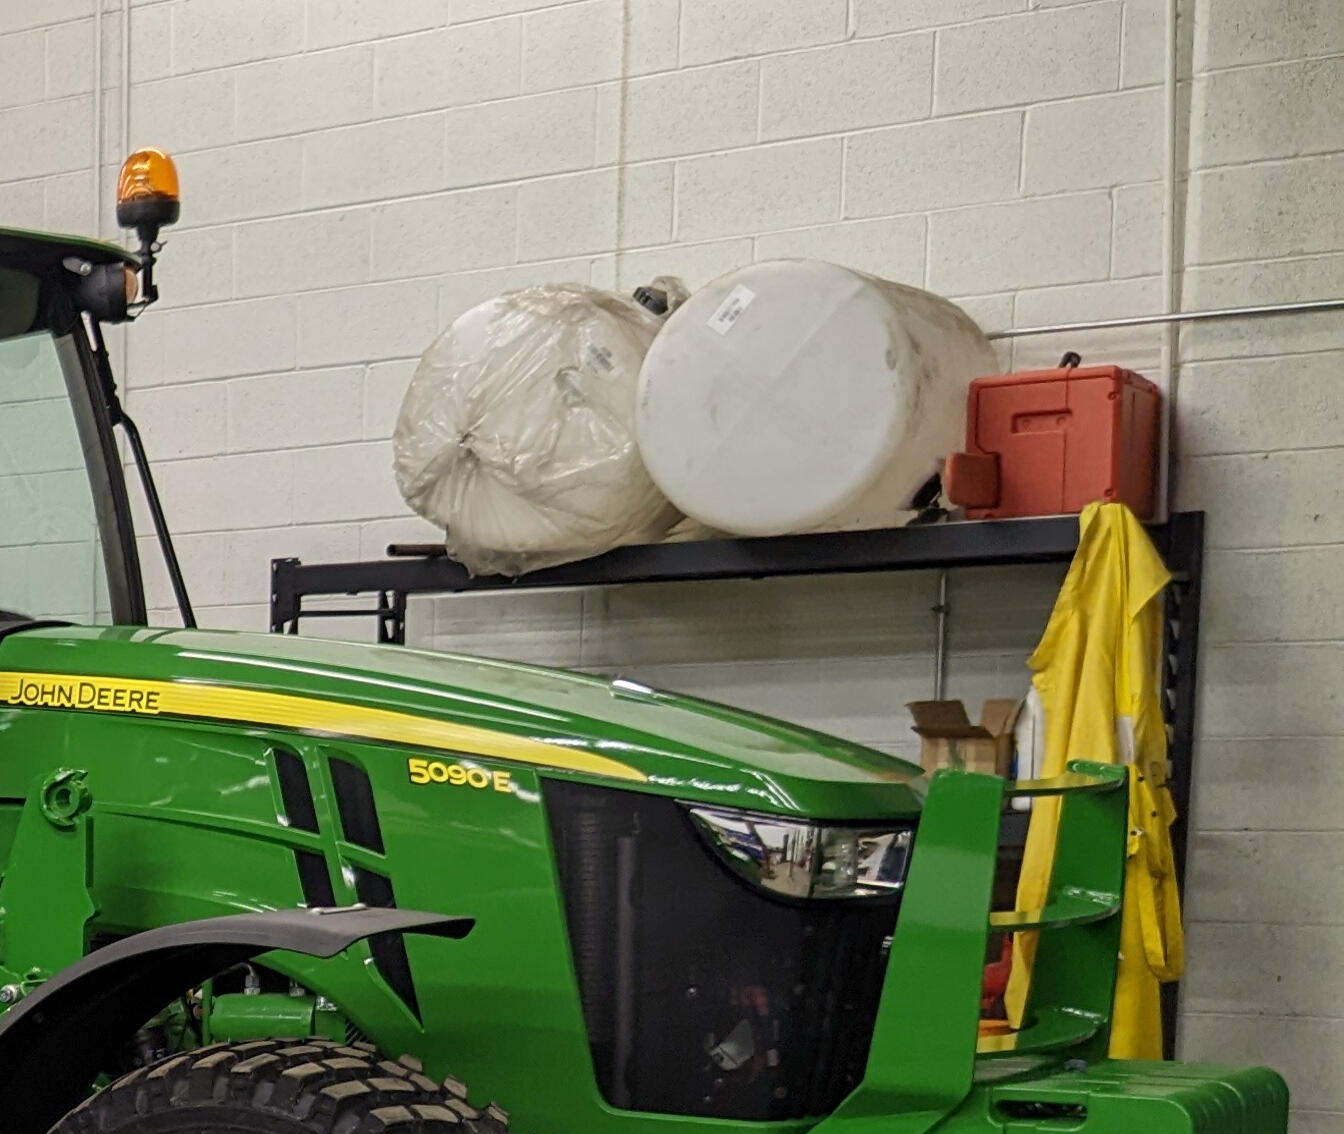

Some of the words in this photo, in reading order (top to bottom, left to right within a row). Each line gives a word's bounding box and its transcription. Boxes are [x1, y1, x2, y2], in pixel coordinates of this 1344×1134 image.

[10, 678, 73, 704] JOHN
[77, 681, 160, 711] DEERE
[408, 758, 489, 789] 5090
[493, 770, 512, 793] E
